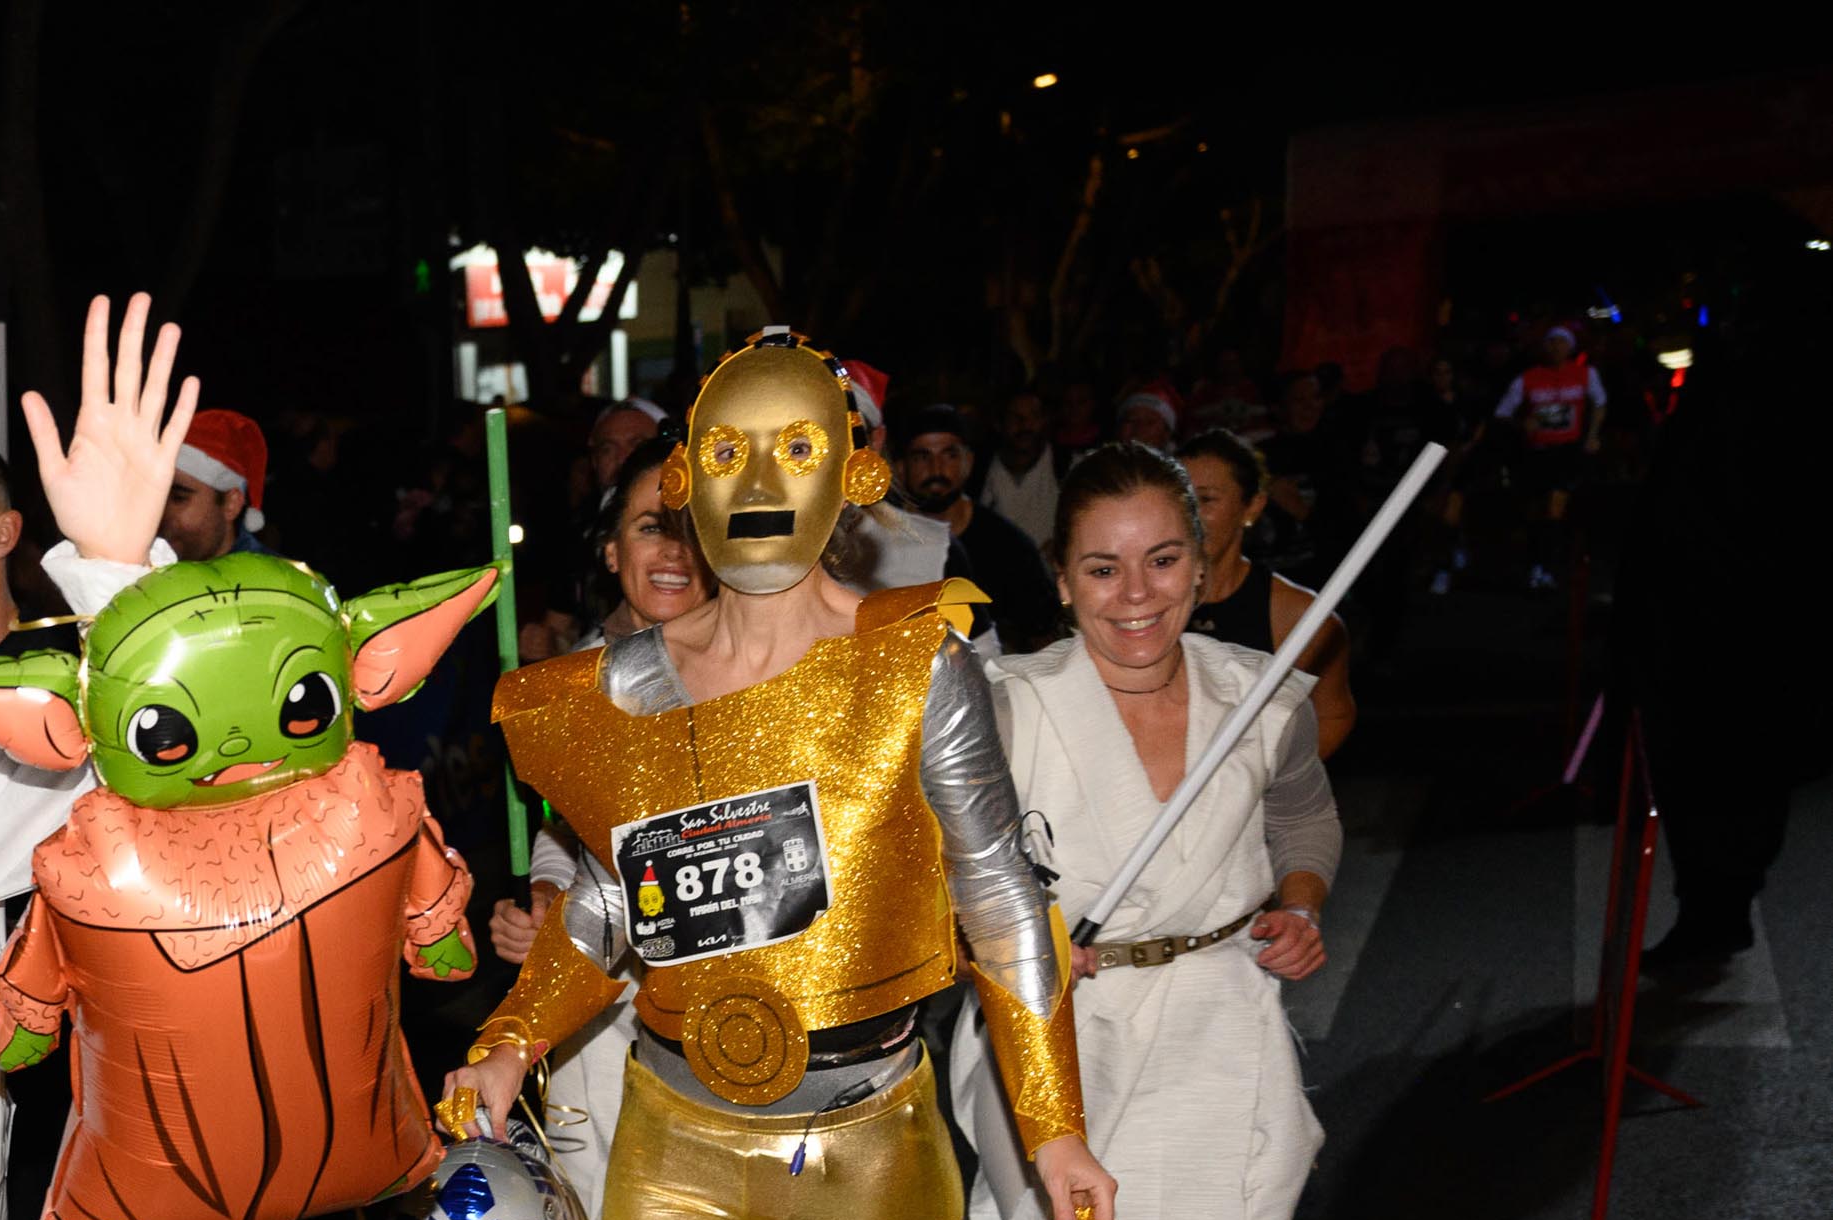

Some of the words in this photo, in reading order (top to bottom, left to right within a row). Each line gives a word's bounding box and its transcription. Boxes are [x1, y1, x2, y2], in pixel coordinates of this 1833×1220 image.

[679, 813, 707, 831] San
[709, 800, 771, 825] Silvestre
[667, 846, 695, 858] CORRE
[696, 841, 716, 852] POR
[718, 837, 731, 847] TU
[732, 830, 765, 843] CIUDAD
[675, 852, 764, 902] 878
[720, 898, 739, 911] DEL
